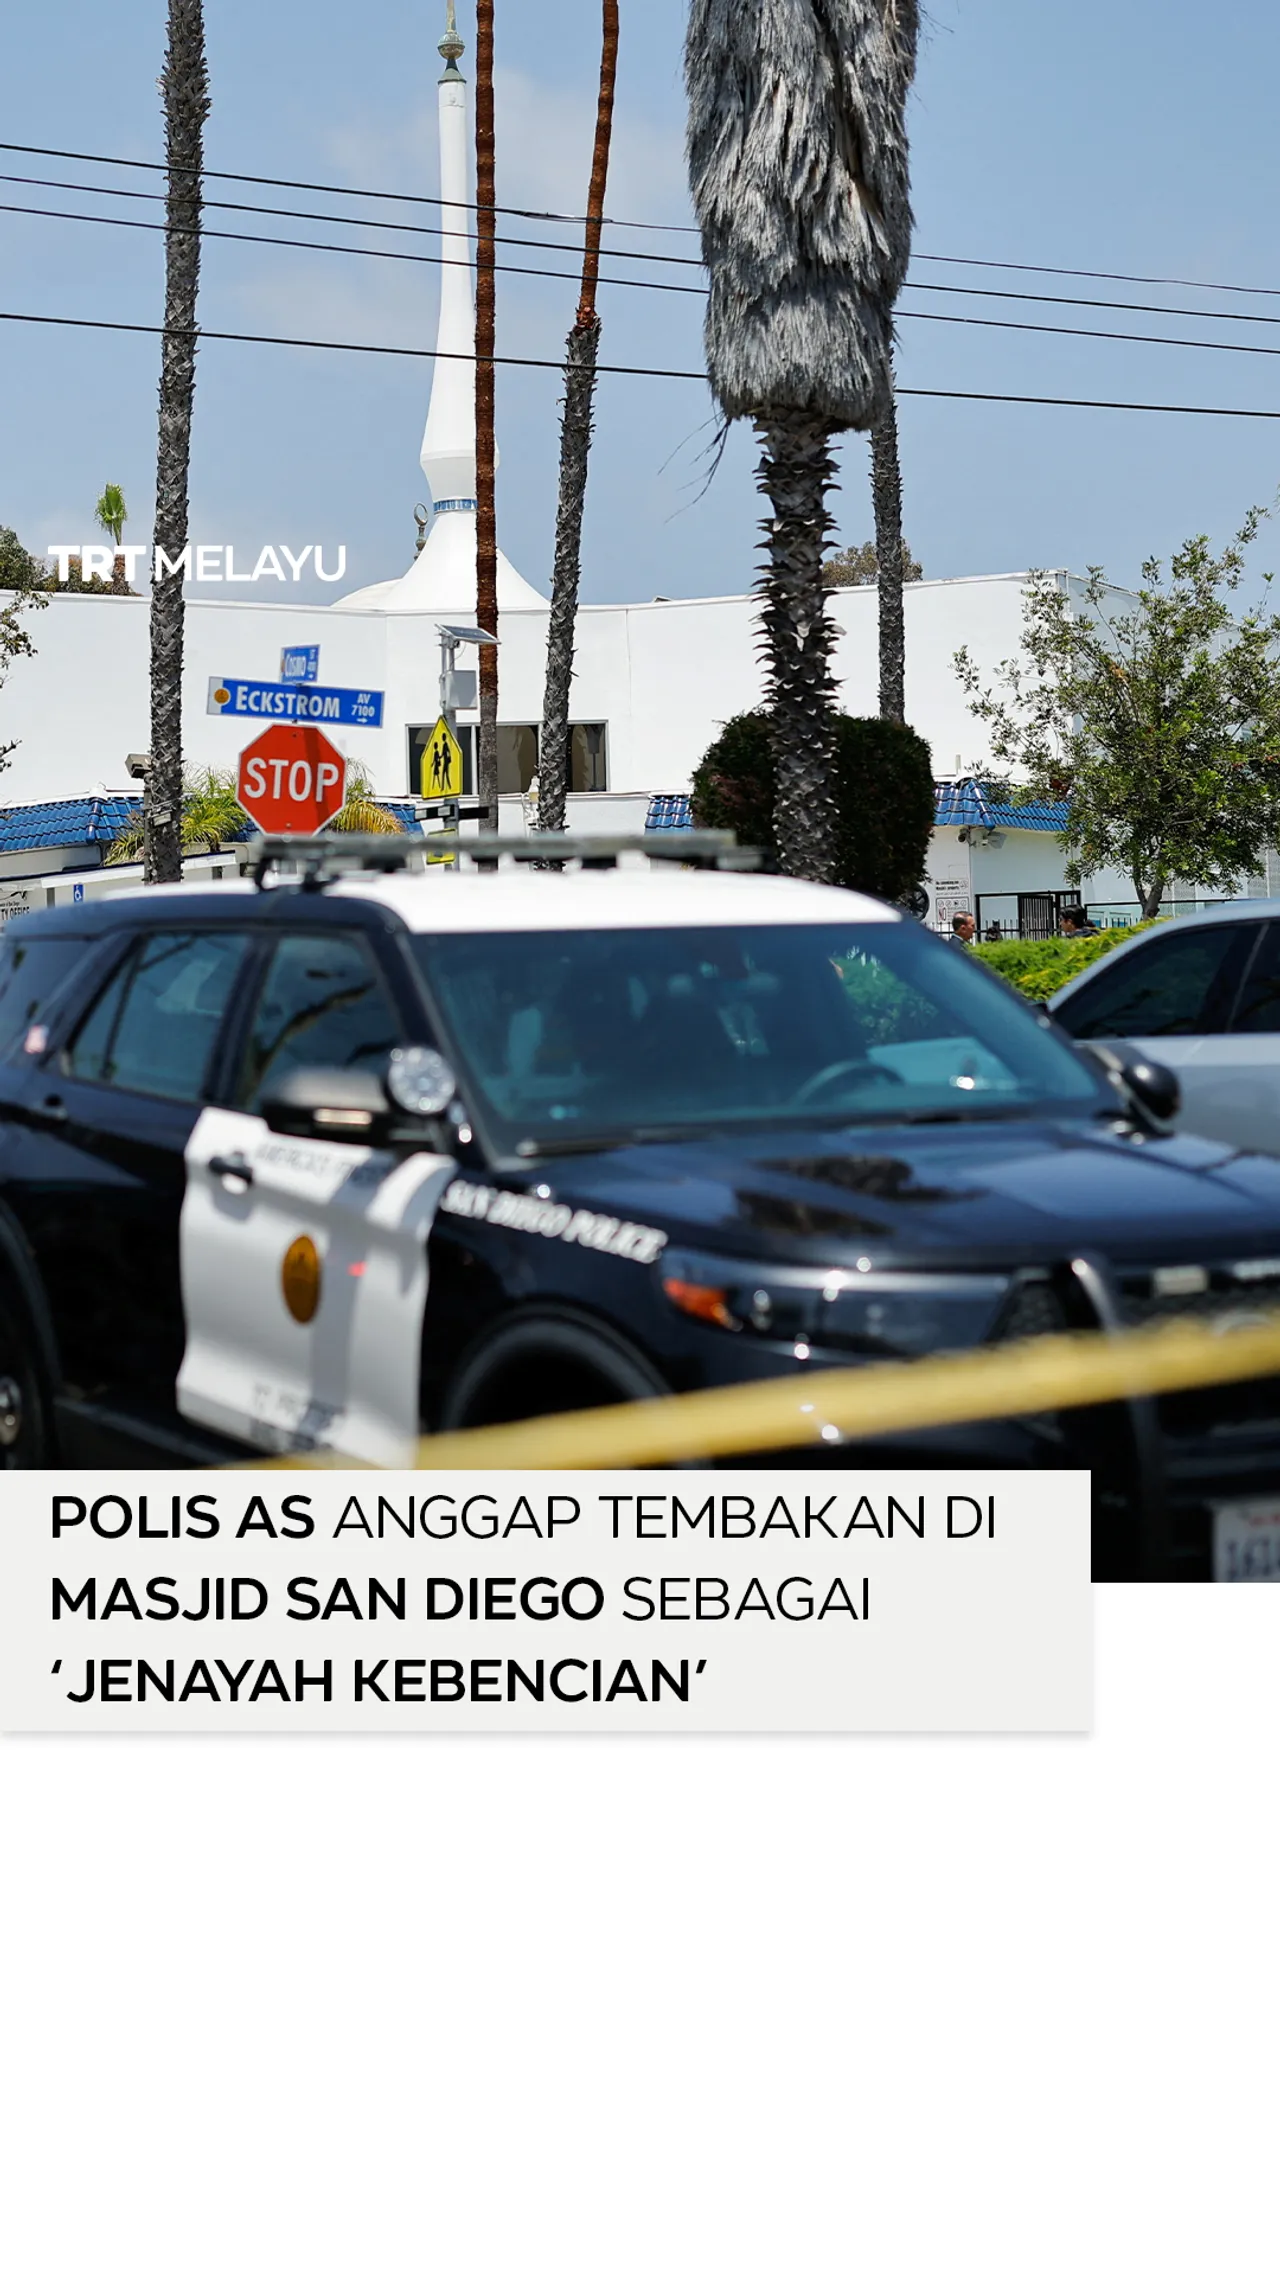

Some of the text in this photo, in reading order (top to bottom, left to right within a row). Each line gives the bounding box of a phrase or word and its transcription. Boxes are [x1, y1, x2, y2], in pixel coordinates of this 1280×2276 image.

[235, 685, 340, 718] ECKSTROM
[351, 704, 375, 717] 7100
[357, 693, 371, 705] AV
[244, 757, 339, 803] STOP
[486, 1190, 572, 1238] DIEGO
[561, 1209, 668, 1264] POLICE
